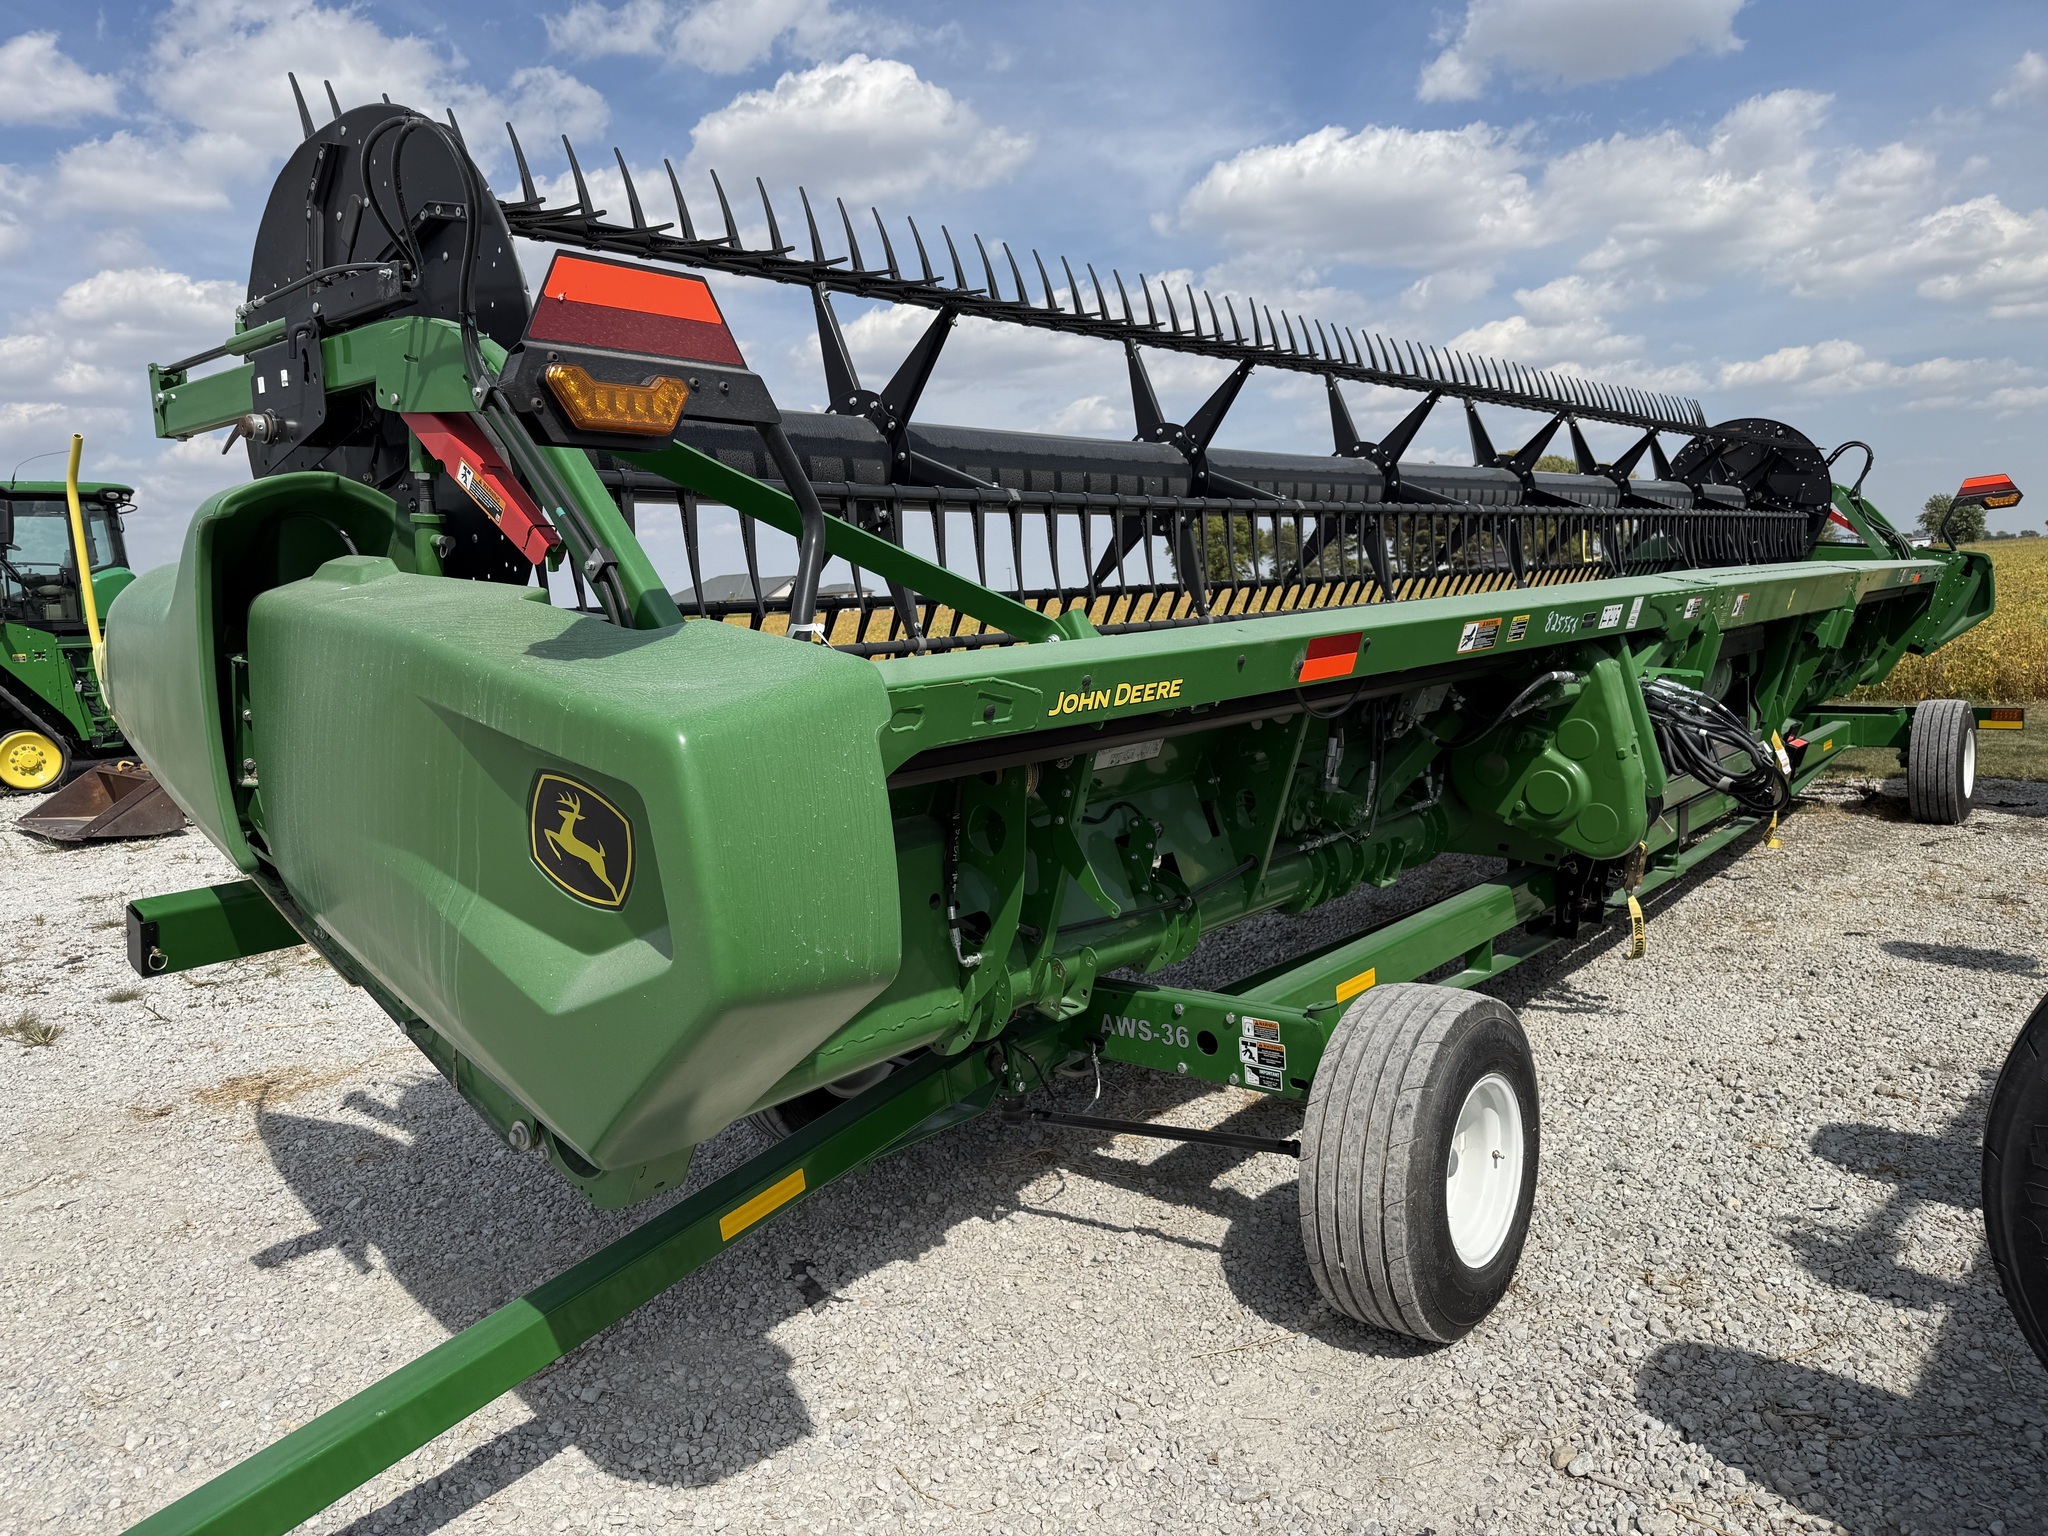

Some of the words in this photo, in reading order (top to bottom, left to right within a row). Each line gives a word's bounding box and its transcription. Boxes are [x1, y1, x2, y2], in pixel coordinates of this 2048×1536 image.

[1047, 688, 1112, 717] JOHN
[1113, 678, 1184, 707] DEERE
[1100, 1013, 1190, 1048] AWS-36
[1258, 1068, 1280, 1078] IMPORTANT
